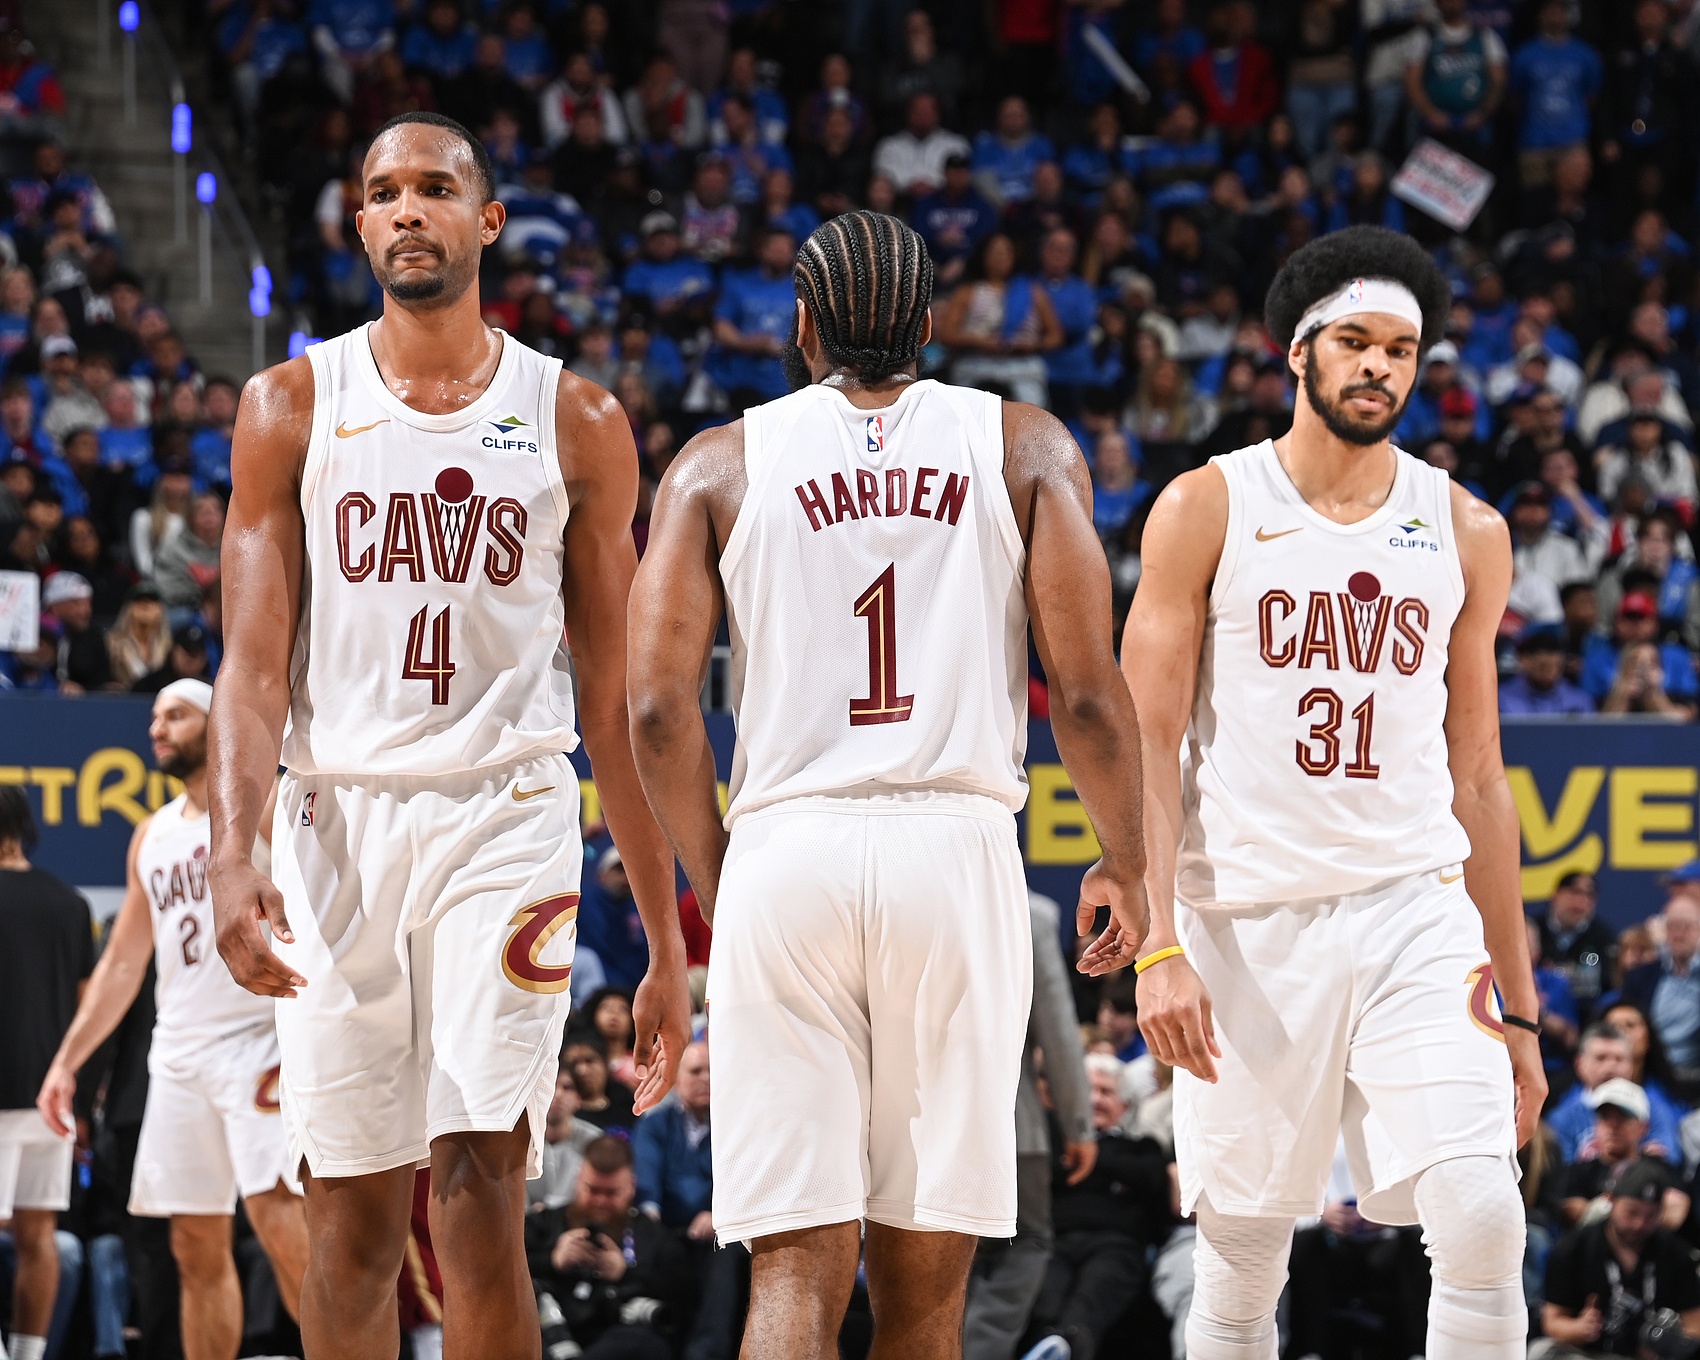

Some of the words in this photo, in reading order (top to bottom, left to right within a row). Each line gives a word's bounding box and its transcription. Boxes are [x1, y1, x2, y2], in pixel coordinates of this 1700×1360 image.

[481, 436, 538, 453] CLIFFS
[795, 467, 970, 532] HARDEN
[336, 491, 528, 587] CAVS
[1389, 536, 1438, 551] CLIFFS
[402, 603, 456, 706] 4
[849, 561, 915, 726] 1
[1258, 588, 1430, 676] CAVS
[1295, 687, 1381, 780] 31
[151, 860, 208, 911] CAV
[179, 915, 199, 966] 2
